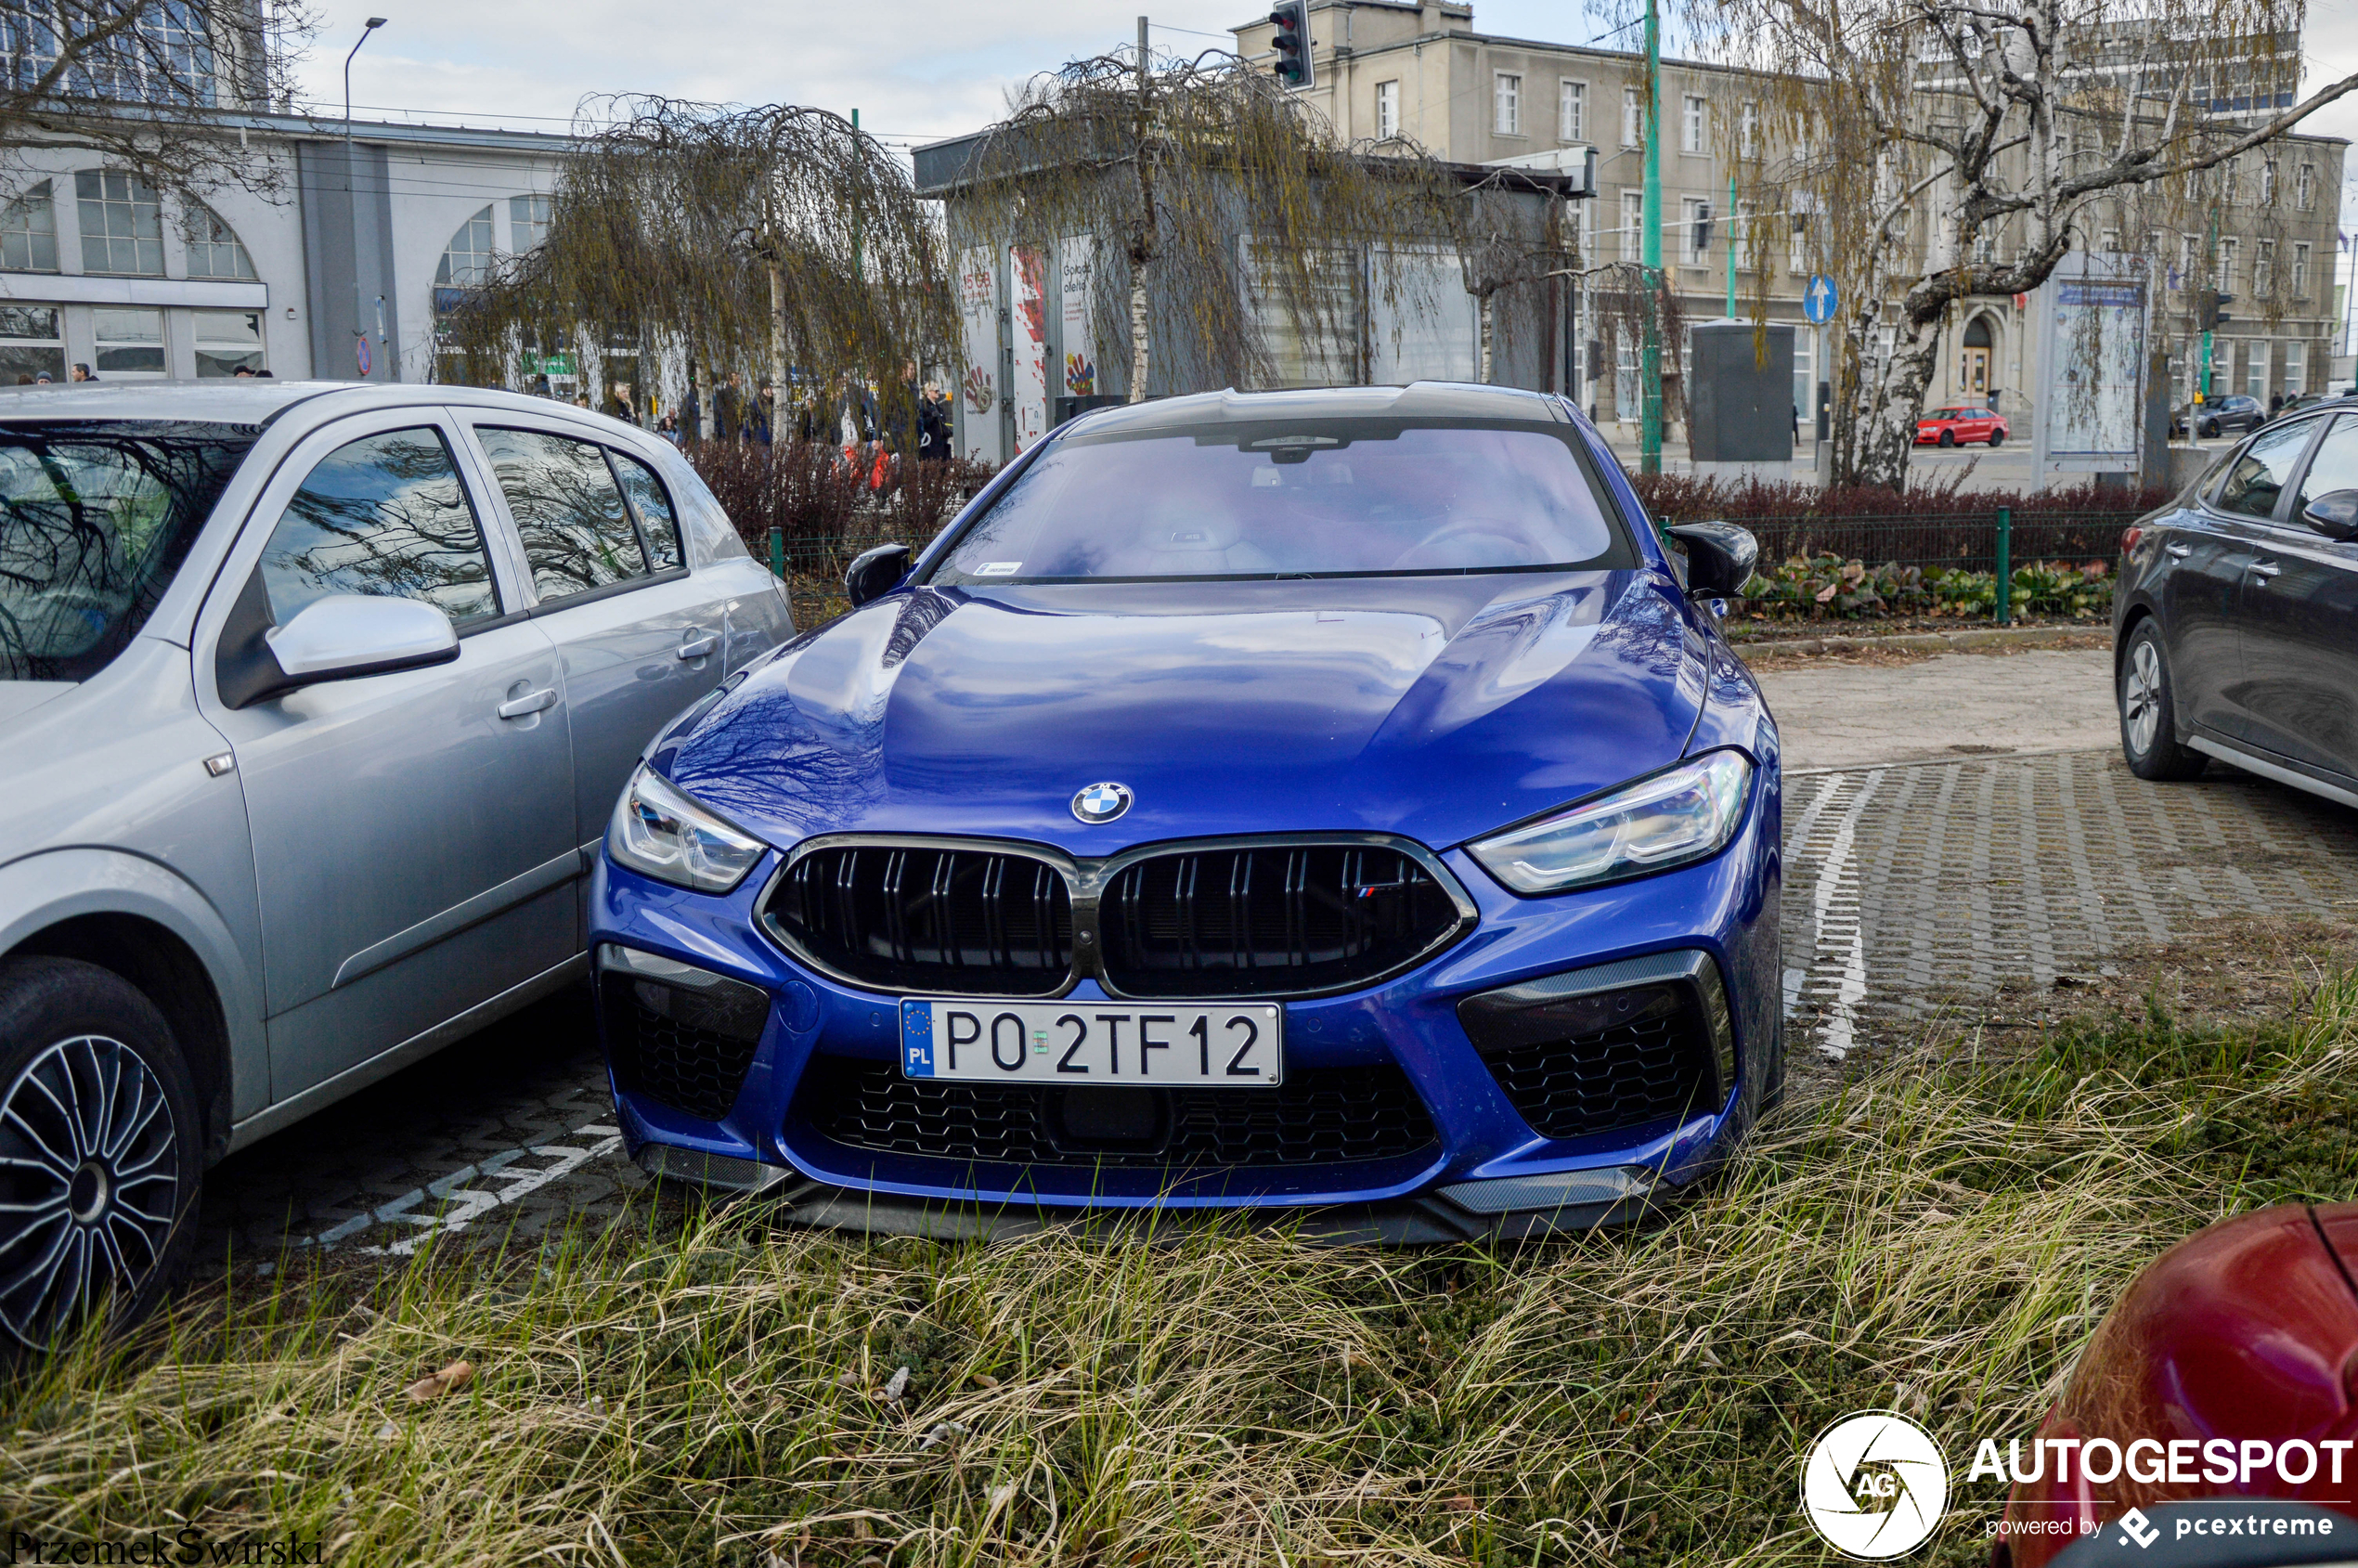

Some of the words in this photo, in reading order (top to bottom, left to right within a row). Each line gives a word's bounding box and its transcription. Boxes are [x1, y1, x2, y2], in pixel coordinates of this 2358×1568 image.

[1081, 784, 1128, 796] BMW
[946, 1011, 1026, 1071] PO
[1056, 1013, 1261, 1076] 2TF12
[909, 1047, 930, 1065] PL
